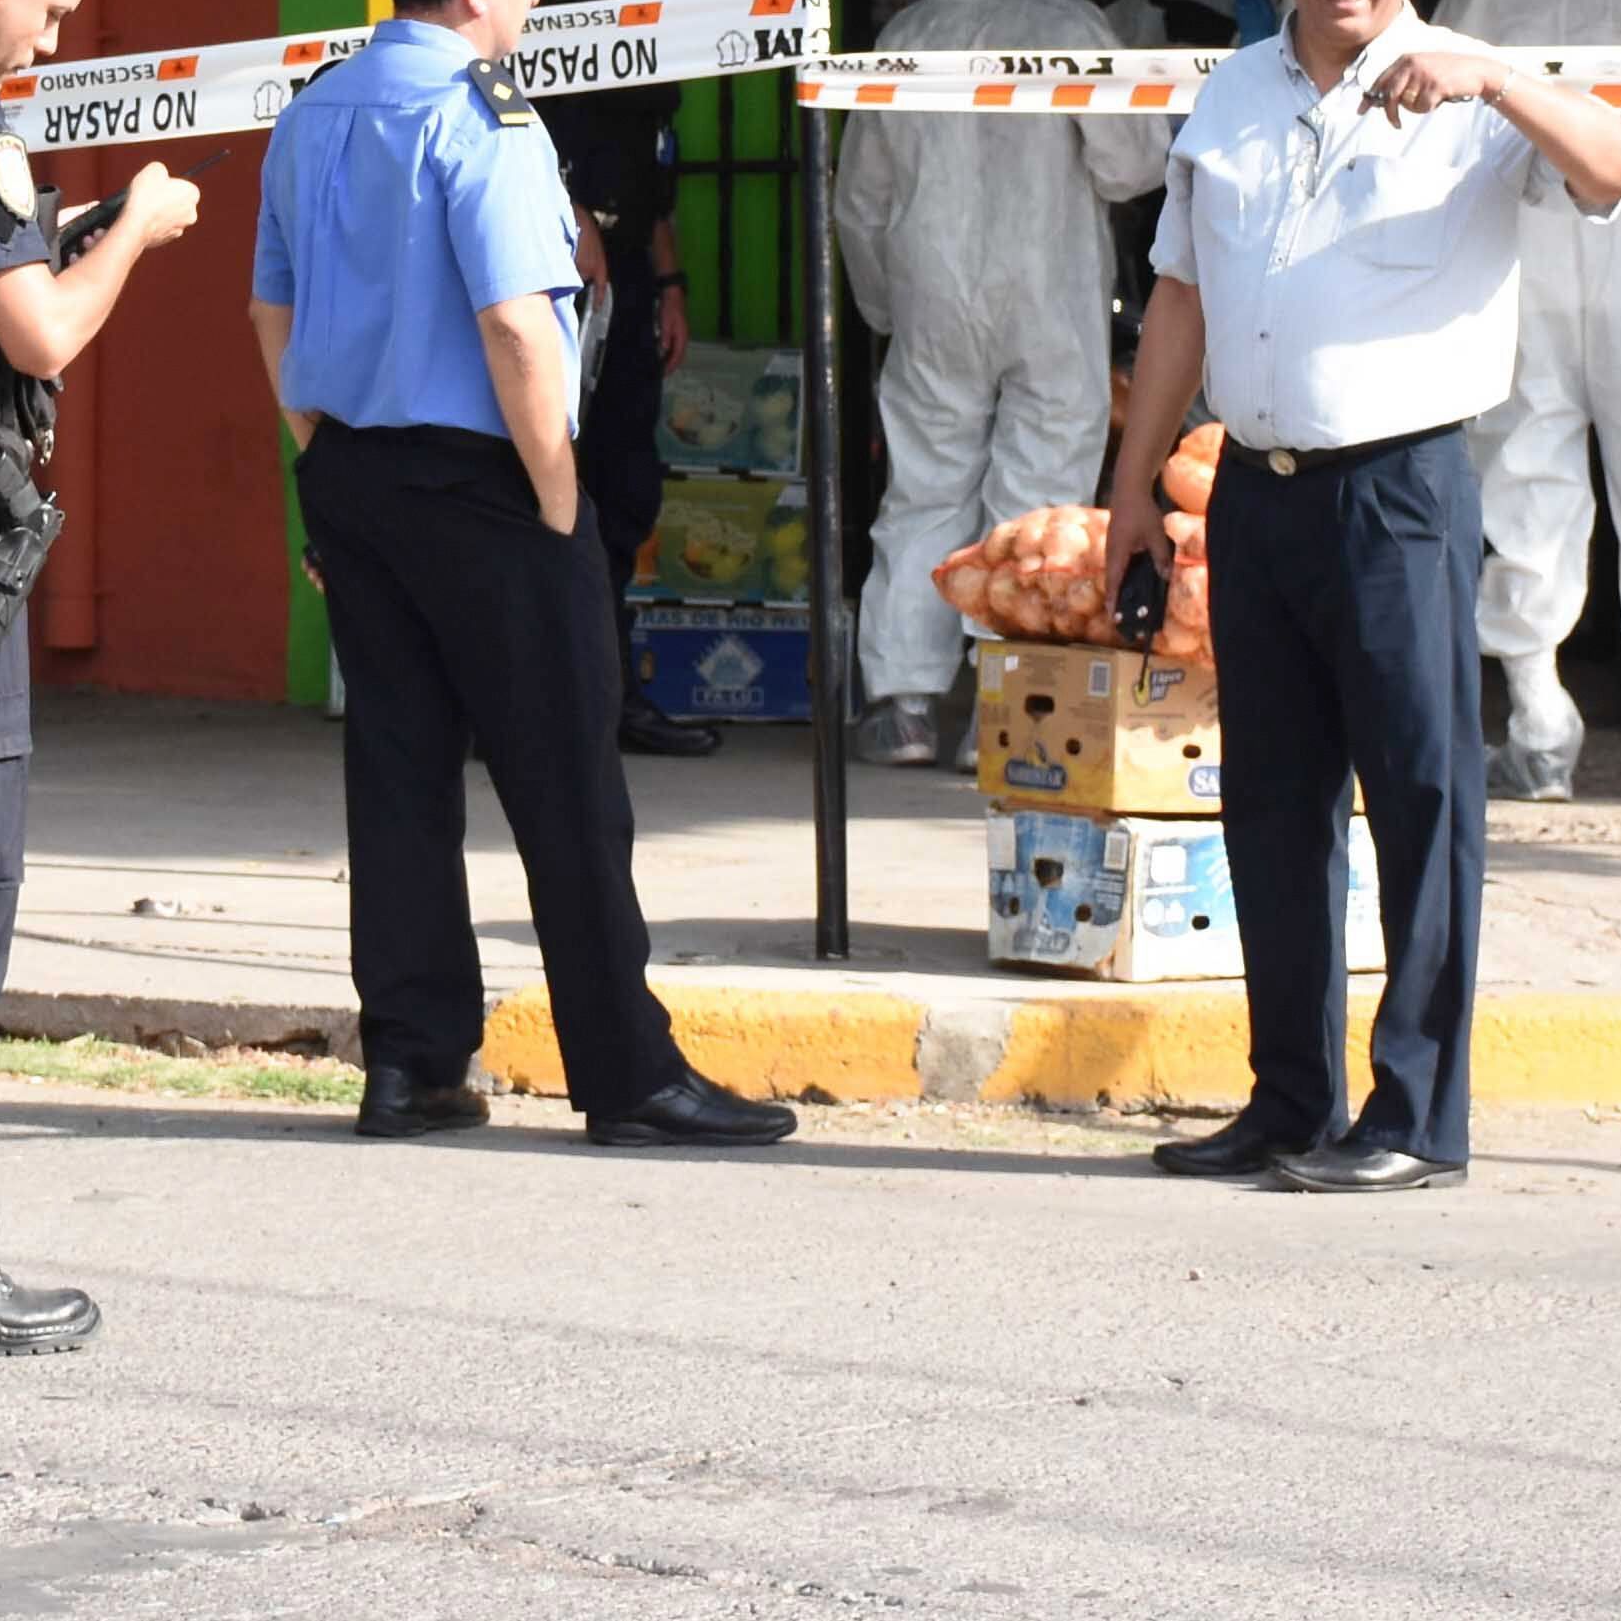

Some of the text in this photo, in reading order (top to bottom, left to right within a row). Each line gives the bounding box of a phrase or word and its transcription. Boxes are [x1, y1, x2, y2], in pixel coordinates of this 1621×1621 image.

[40, 63, 155, 92] ESCENARIO
[611, 37, 658, 80] NO
[44, 89, 197, 144] NO PASAR
